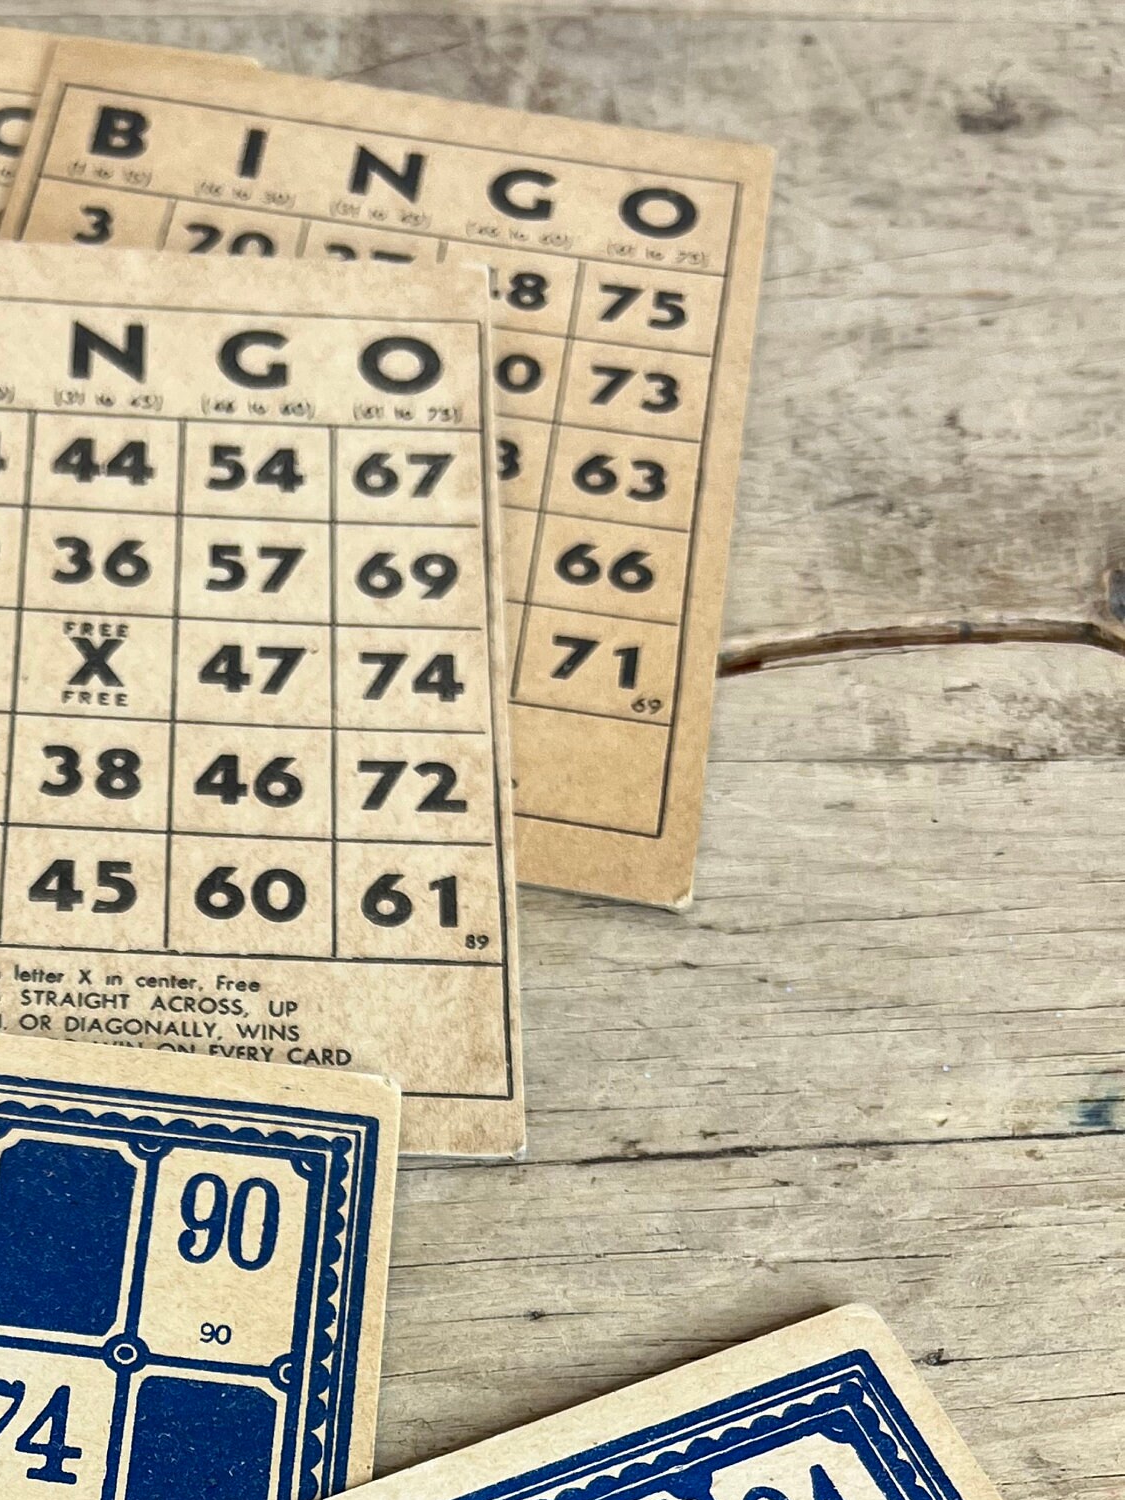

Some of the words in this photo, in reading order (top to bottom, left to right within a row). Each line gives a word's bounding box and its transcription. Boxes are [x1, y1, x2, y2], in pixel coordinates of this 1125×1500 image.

[73, 206, 113, 244] 3
[600, 284, 686, 329] 75
[591, 365, 679, 413] 73
[53, 437, 154, 485] 44
[207, 444, 304, 493] 54
[353, 452, 453, 497] 67
[573, 454, 666, 501] 63
[53, 536, 150, 587] 36
[206, 544, 305, 592] 57
[356, 552, 458, 599] 69
[555, 543, 654, 593] 66
[68, 637, 123, 687] X
[199, 645, 306, 694] 47
[359, 652, 464, 702] 74
[552, 635, 640, 689] 71
[40, 745, 141, 799] 38
[194, 754, 303, 807] 46
[358, 760, 467, 813] 72
[29, 859, 137, 913] 45
[195, 866, 306, 922] 60
[361, 873, 458, 927] 61
[14, 964, 64, 983] letter
[79, 969, 92, 985] X
[106, 975, 122, 985] in
[217, 975, 261, 992] Free
[21, 989, 130, 1009] STRAIGHT
[269, 1001, 298, 1017] UP
[19, 1014, 51, 1030] OR
[236, 1024, 300, 1042] WINS
[287, 1047, 351, 1066] CARD
[178, 1173, 280, 1271] 90
[200, 1322, 231, 1345] 90
